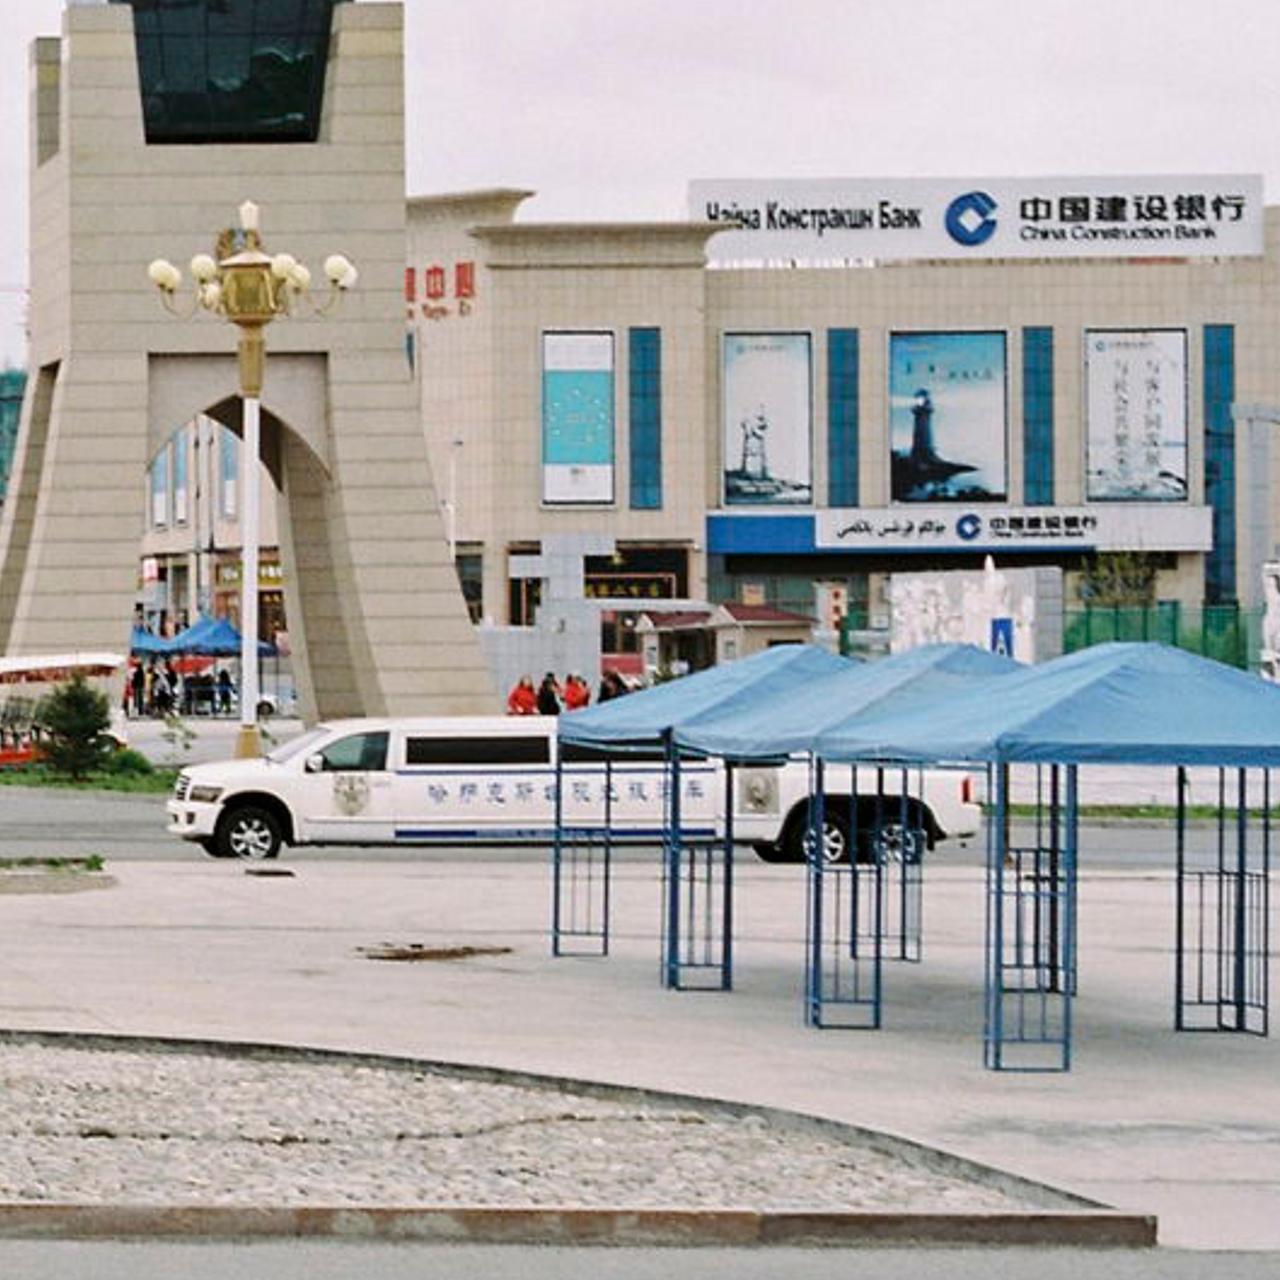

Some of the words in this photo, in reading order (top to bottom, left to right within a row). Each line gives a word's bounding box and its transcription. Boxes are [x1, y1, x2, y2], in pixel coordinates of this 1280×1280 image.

[767, 201, 873, 236] Констракшн
[879, 201, 922, 229] Банк
[1020, 195, 1245, 221] 中国建设银行
[1020, 225, 1067, 240] China
[1071, 225, 1171, 240] Construction
[1175, 225, 1216, 240] Bank
